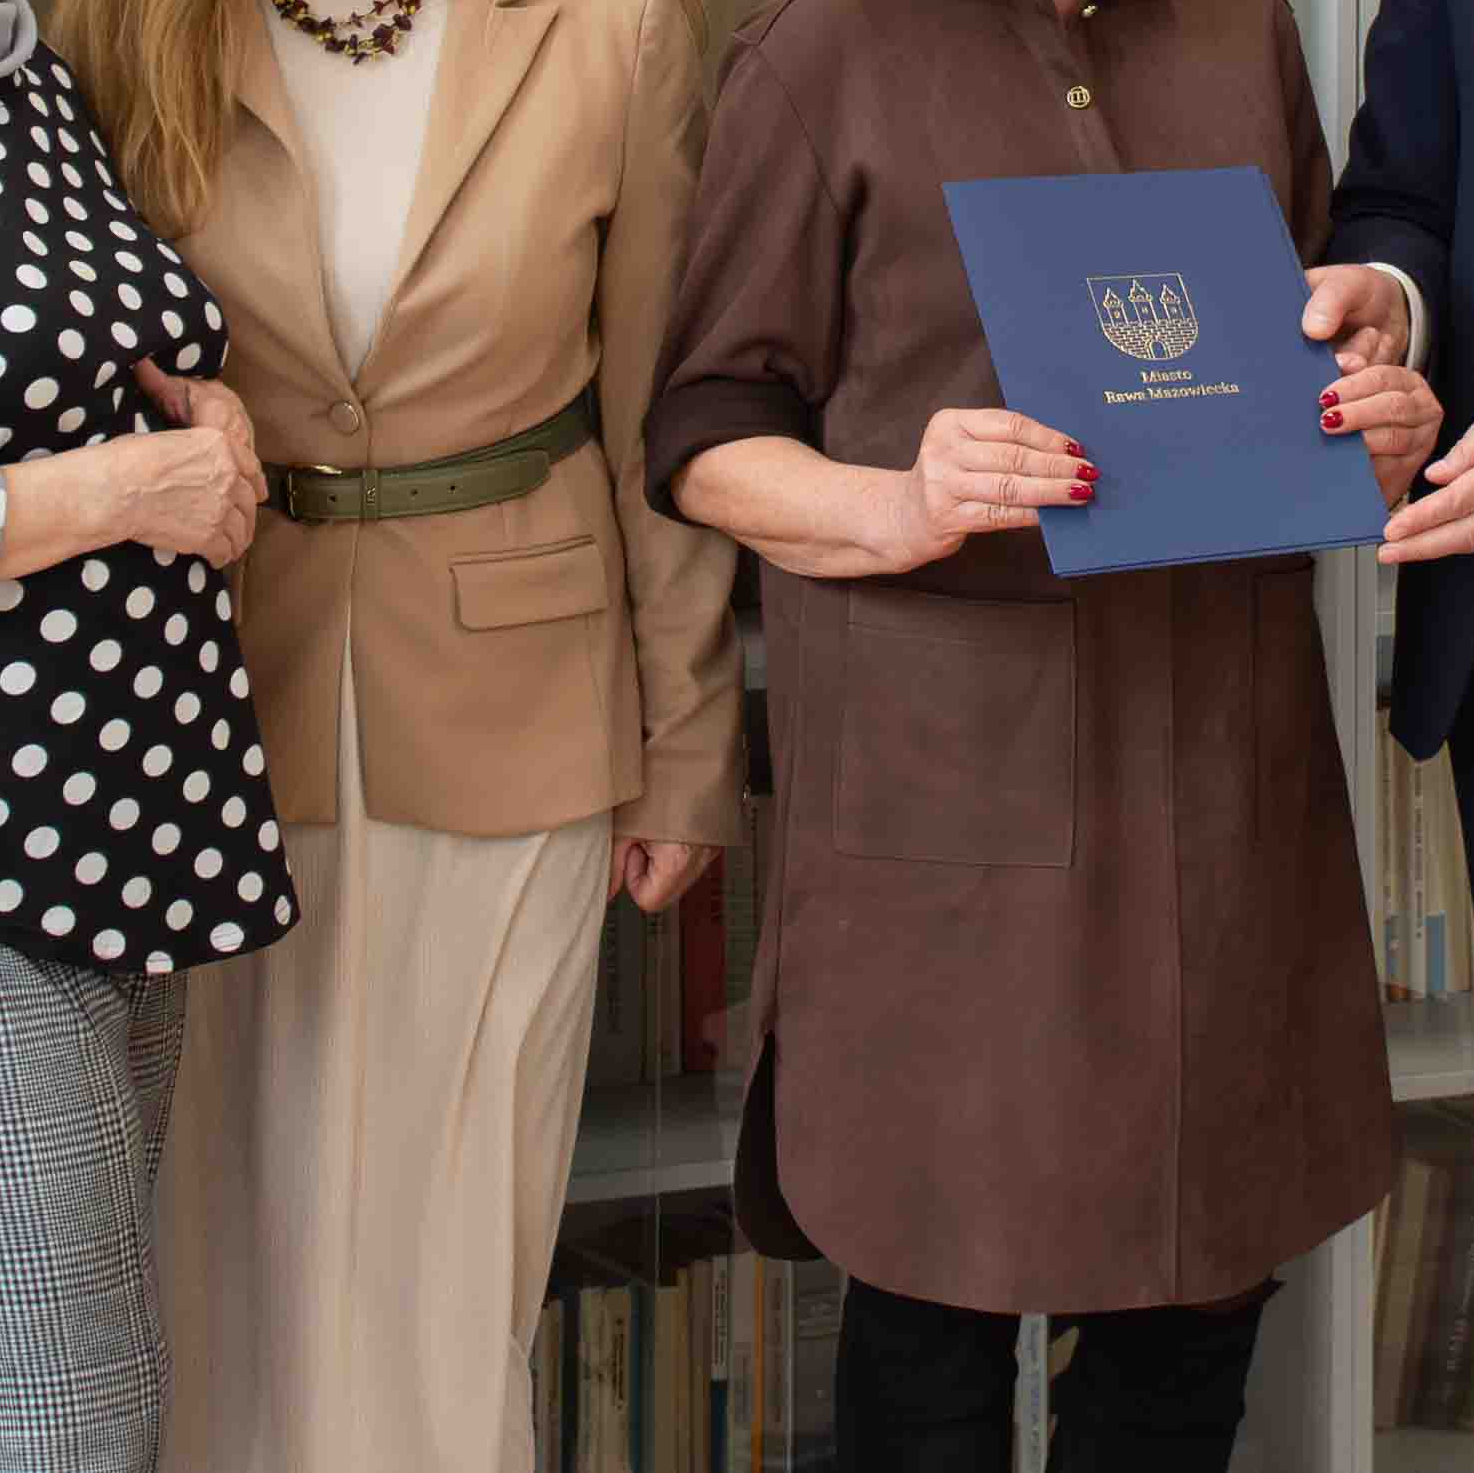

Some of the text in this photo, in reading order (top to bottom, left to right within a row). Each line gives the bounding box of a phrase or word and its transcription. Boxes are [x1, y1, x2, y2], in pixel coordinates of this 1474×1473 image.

[1141, 370, 1192, 383] Miasto
[1104, 381, 1240, 404] Rawa Mazowiecka
